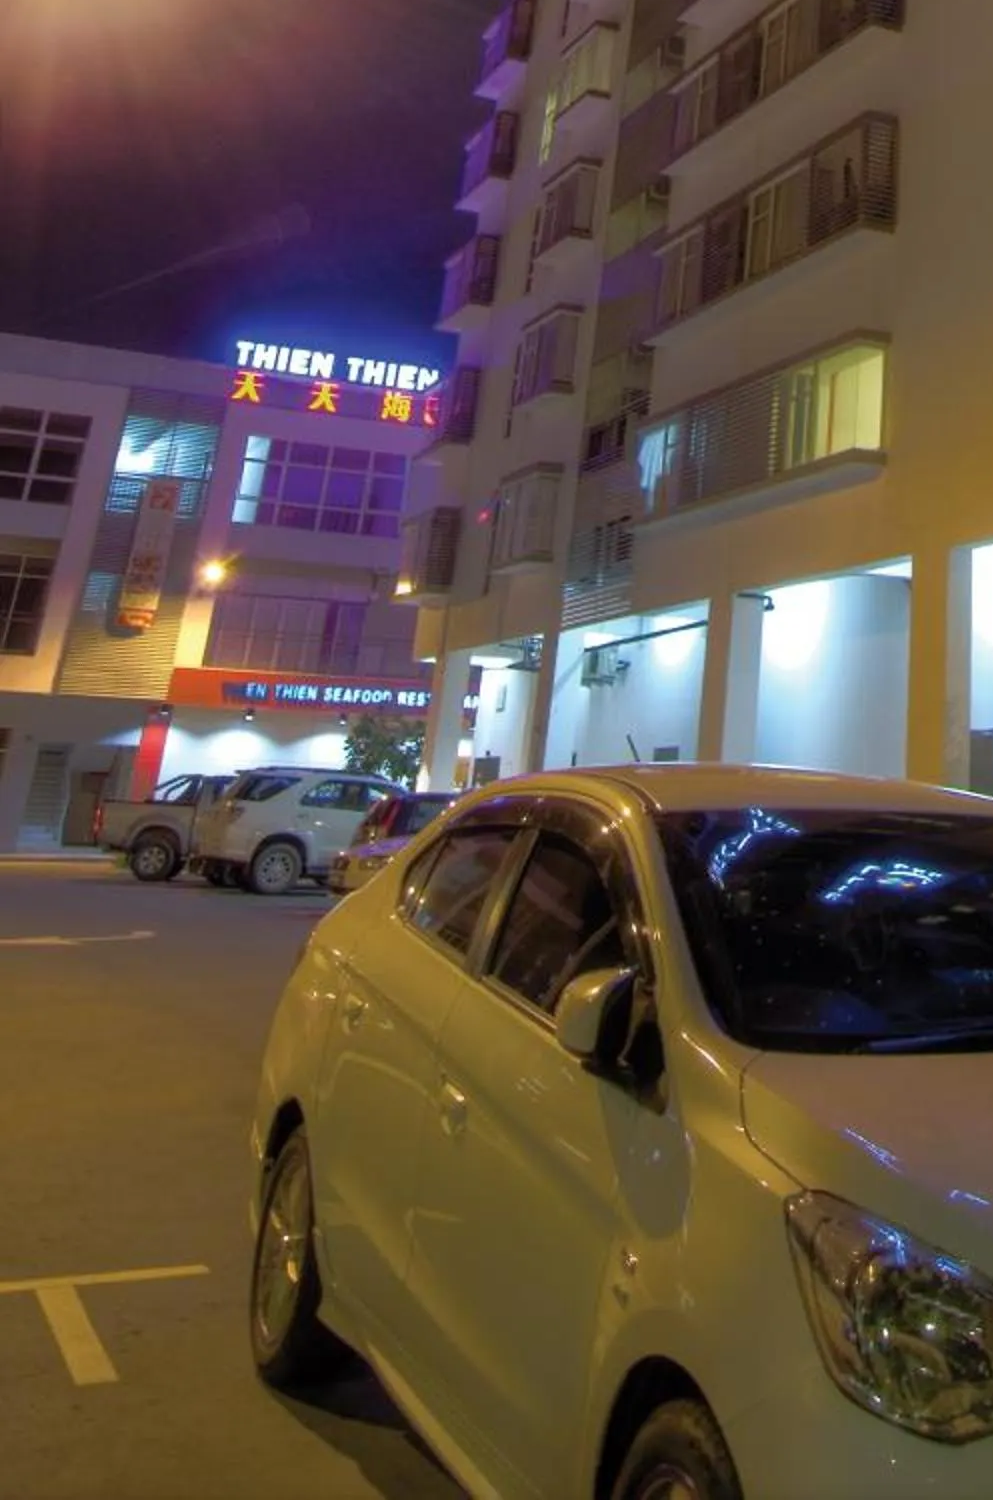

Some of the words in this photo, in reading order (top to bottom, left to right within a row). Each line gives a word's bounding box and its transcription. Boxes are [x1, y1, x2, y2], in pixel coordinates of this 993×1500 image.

[236, 340, 335, 379] THIEN
[347, 356, 440, 391] THIEN
[274, 684, 318, 701] THIEN
